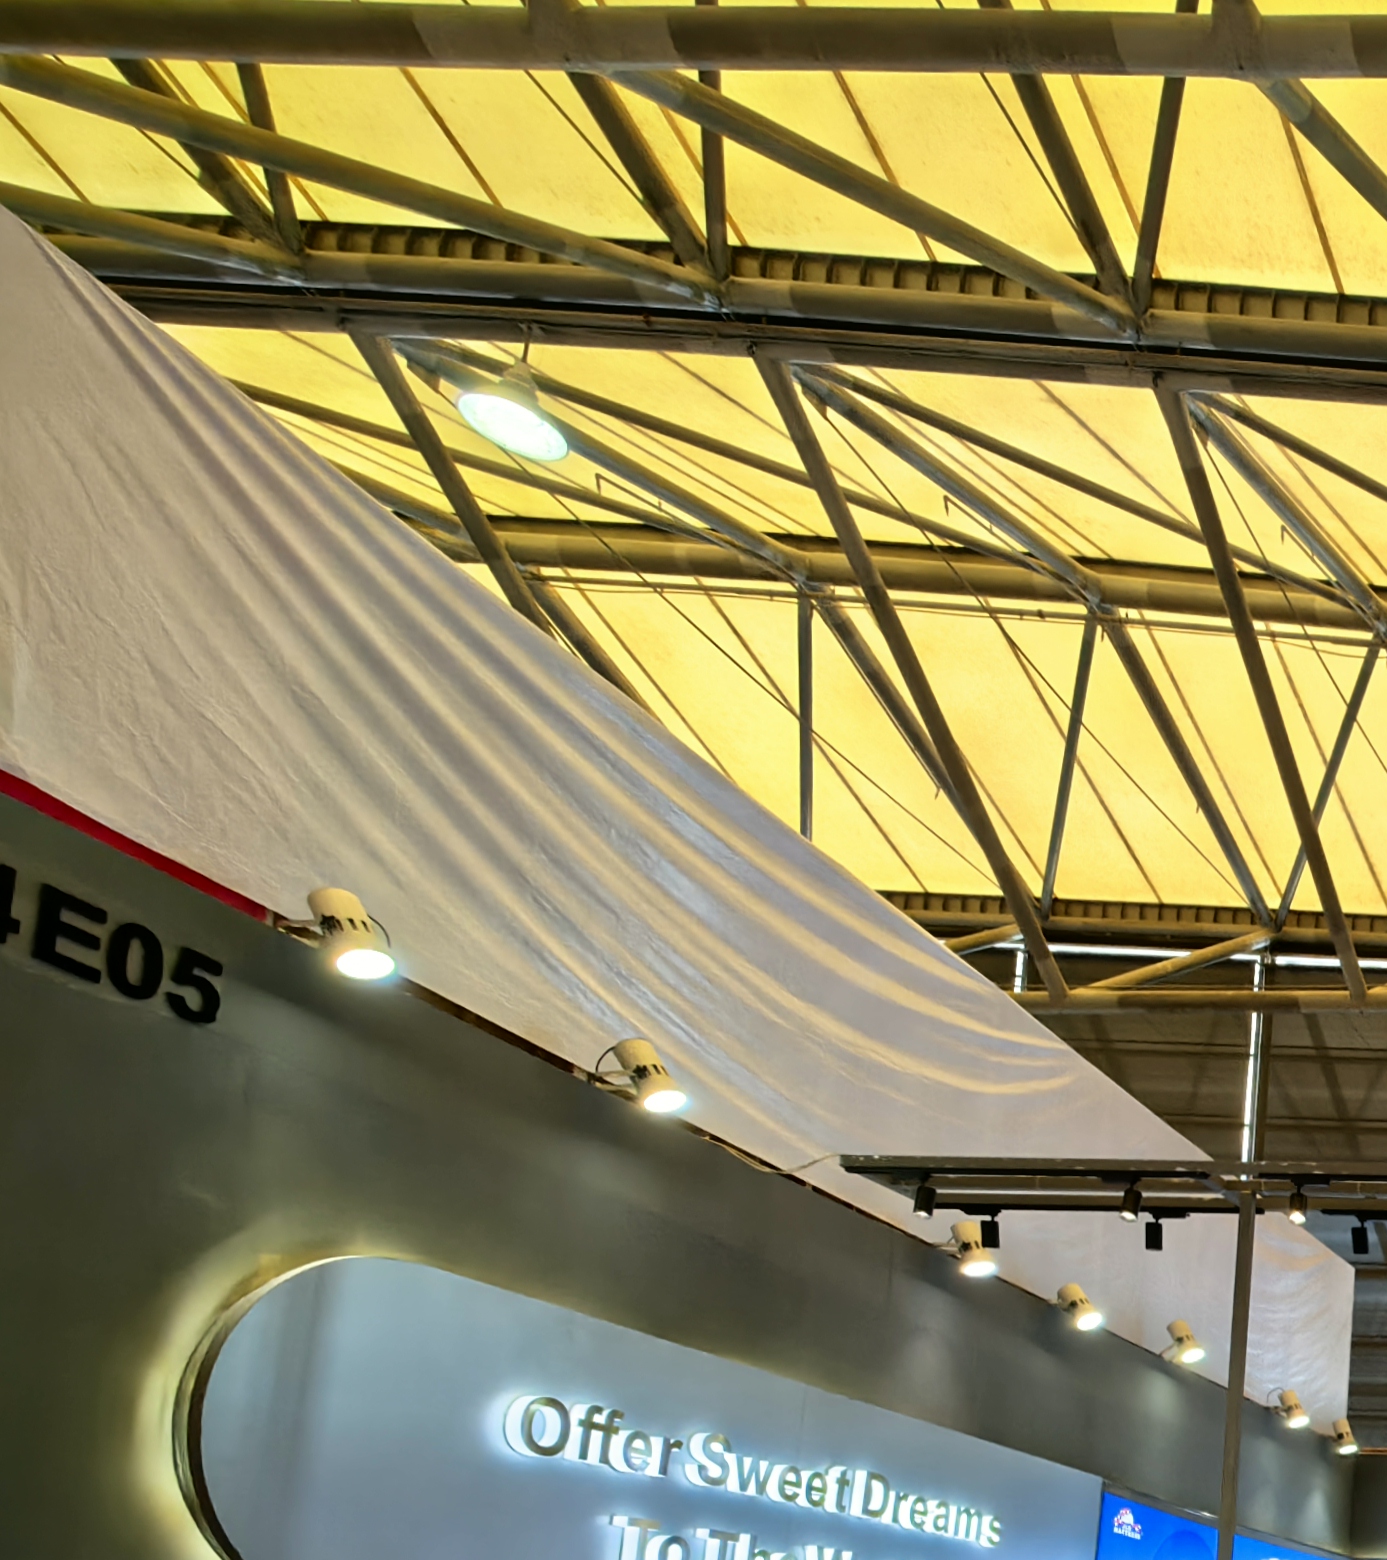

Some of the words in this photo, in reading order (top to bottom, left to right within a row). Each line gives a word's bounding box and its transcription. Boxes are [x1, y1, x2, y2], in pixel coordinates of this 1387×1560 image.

[503, 1394, 683, 1478] Offer
[683, 1431, 851, 1515] Sweet
[850, 1469, 1003, 1549] Dreams
